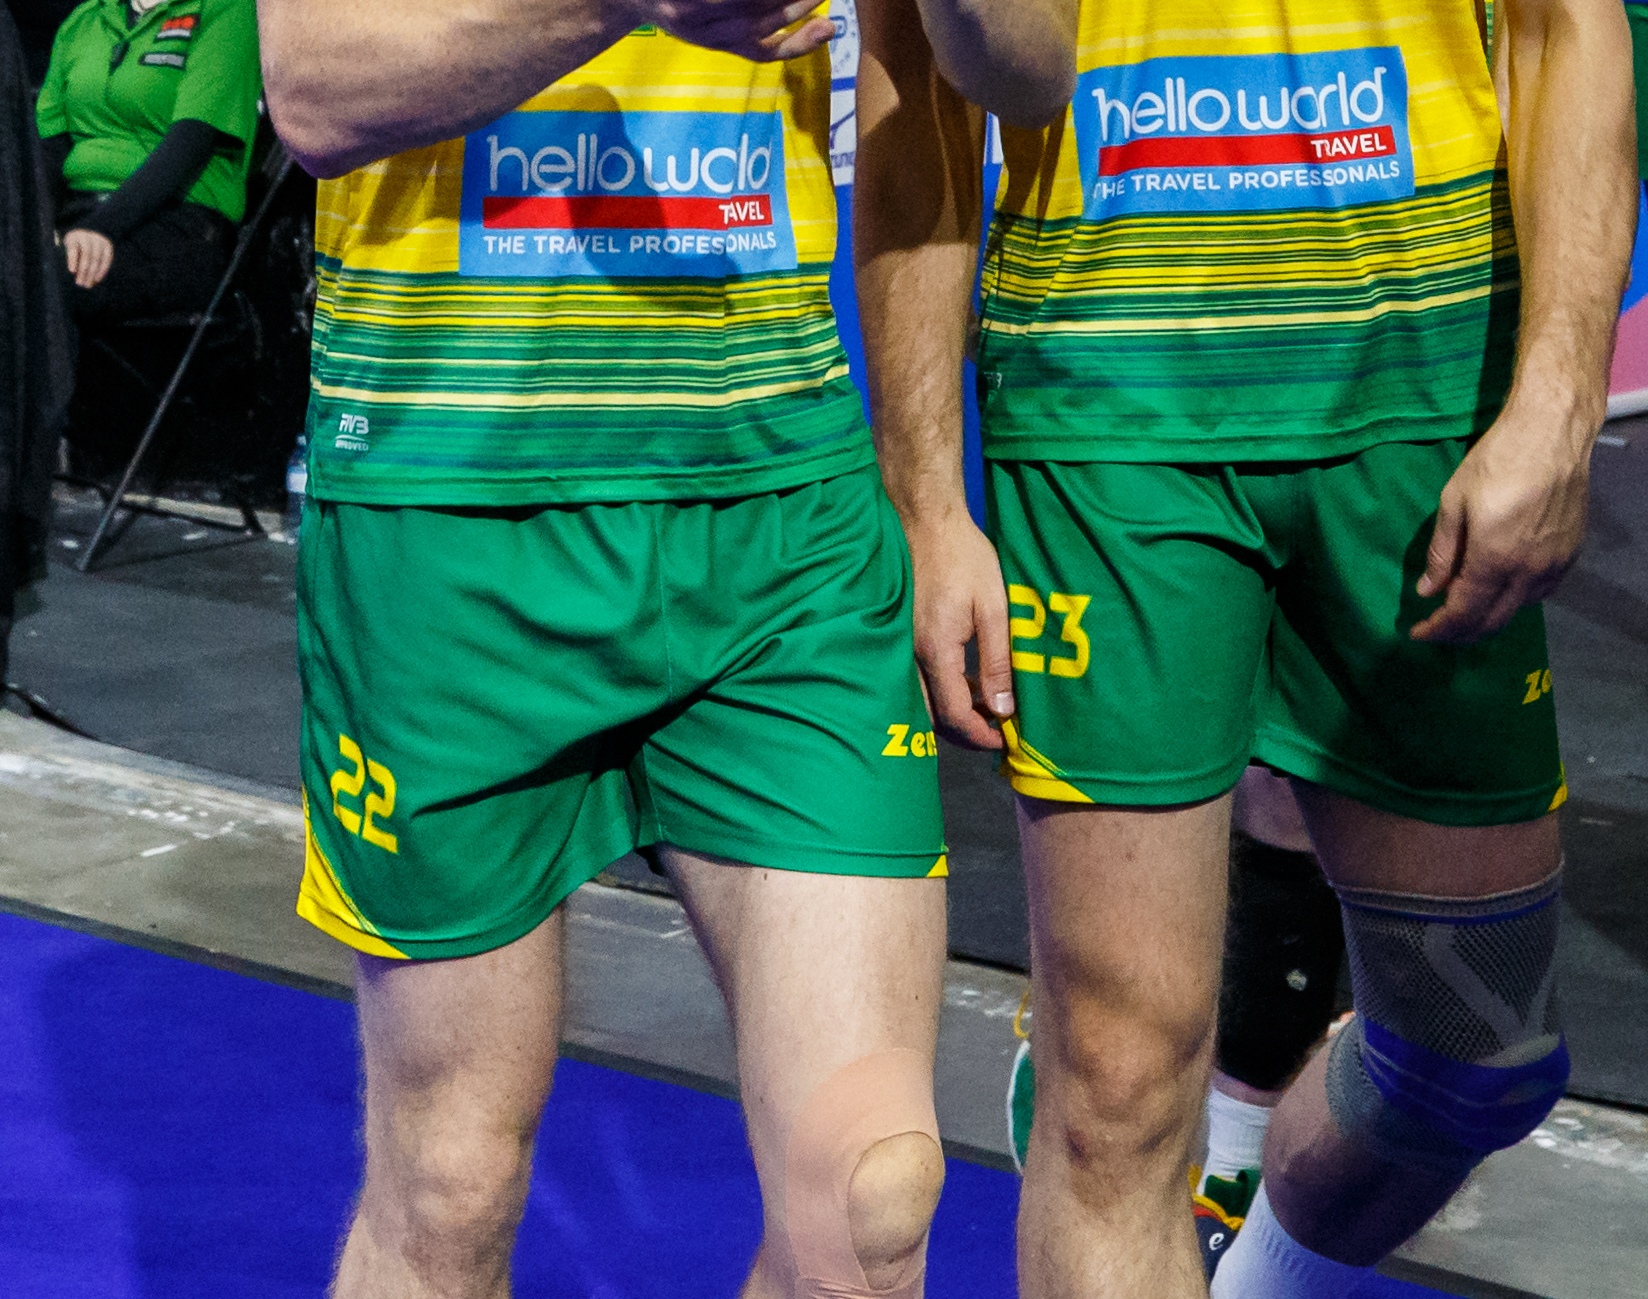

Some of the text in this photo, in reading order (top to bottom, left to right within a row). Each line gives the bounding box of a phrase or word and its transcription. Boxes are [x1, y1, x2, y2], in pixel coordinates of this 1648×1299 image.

[1310, 133, 1388, 158] TRAVEL
[1131, 173, 1221, 192] TRAVEL
[1229, 160, 1400, 191] PROFESSONALS
[718, 201, 765, 225] TAVEL
[483, 235, 526, 255] THE
[533, 235, 621, 255] TRAVEL
[1008, 583, 1091, 679] 23
[881, 723, 938, 758] Zeu
[329, 733, 398, 854] 22
